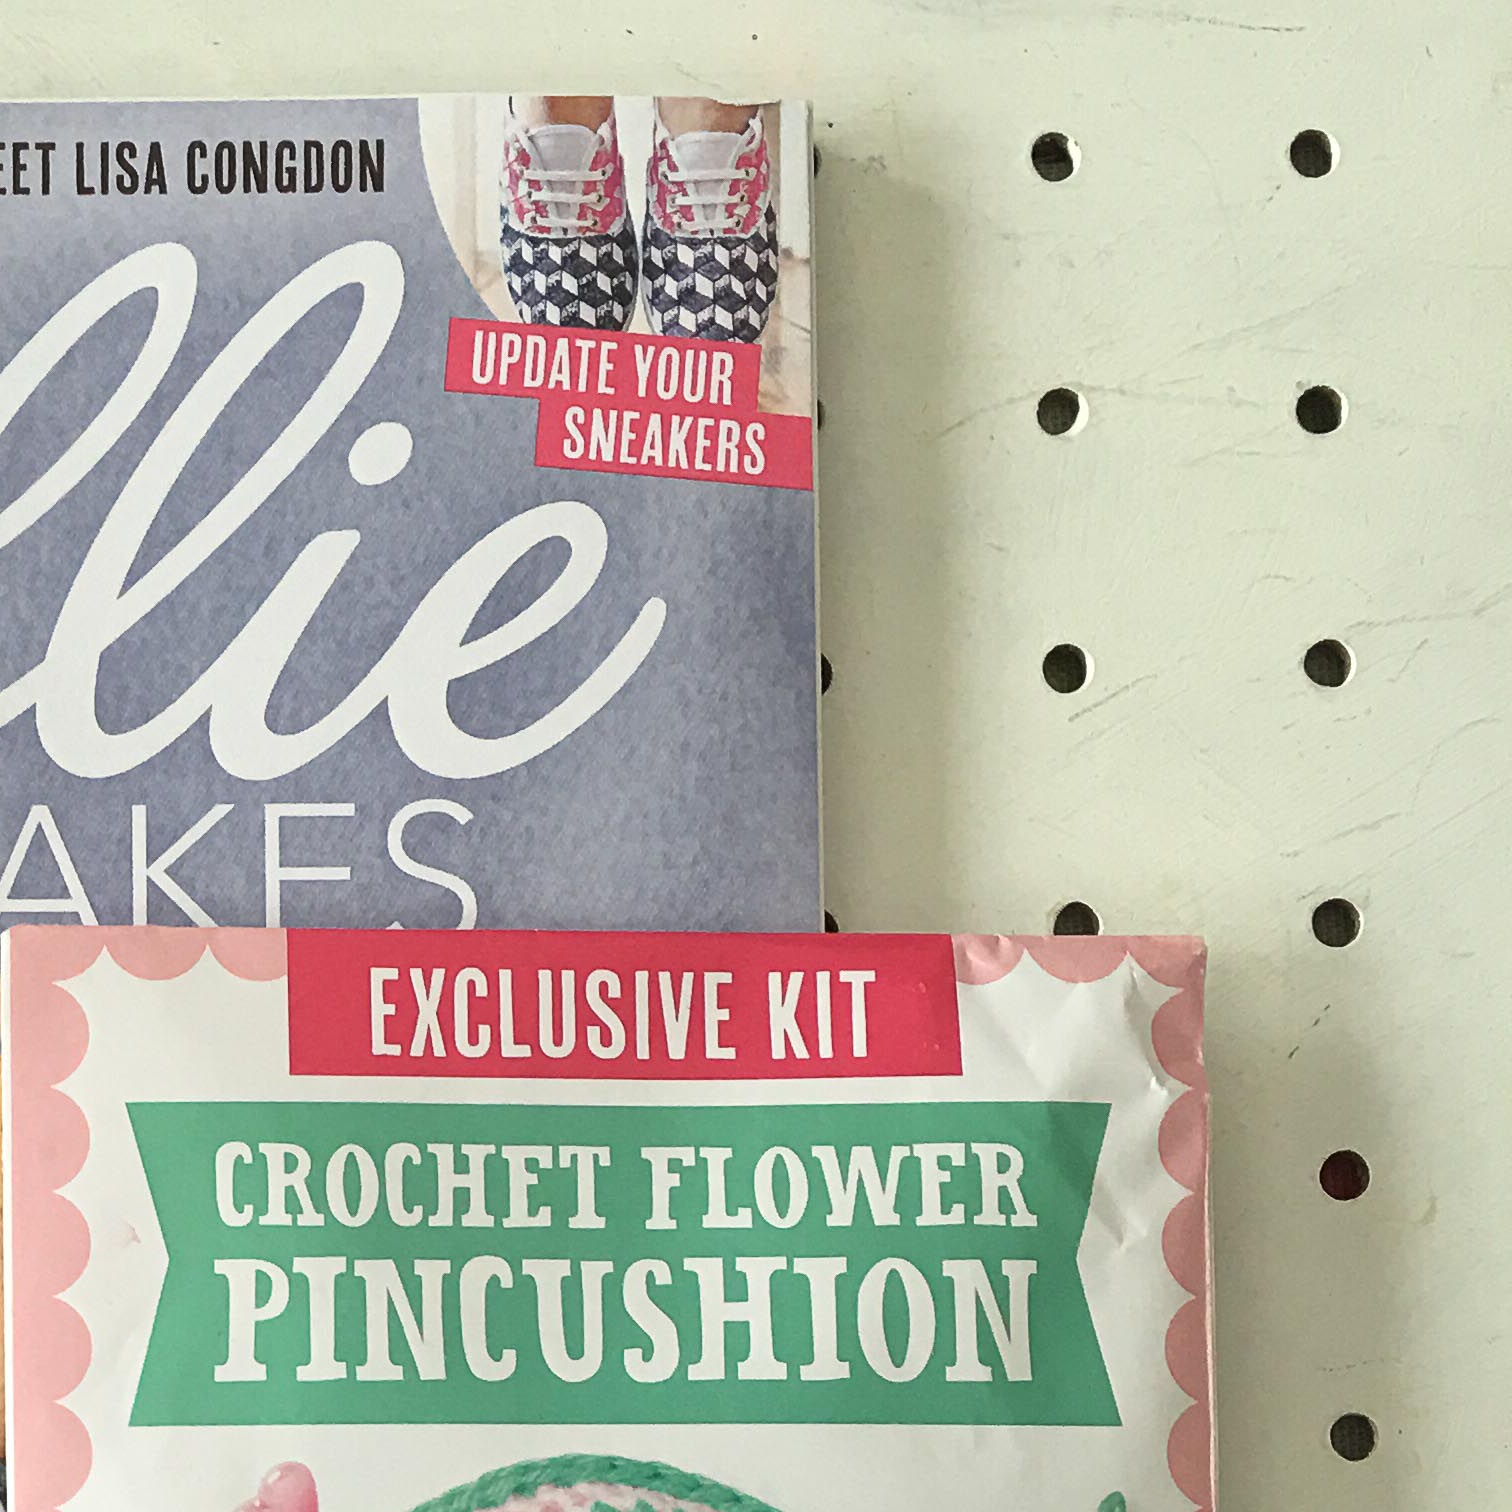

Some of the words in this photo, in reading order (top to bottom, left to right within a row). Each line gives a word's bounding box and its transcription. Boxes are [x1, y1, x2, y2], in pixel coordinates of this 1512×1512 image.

[76, 141, 167, 195] LISA
[188, 138, 385, 193] CONGDON
[471, 330, 617, 395] UPDATE
[634, 344, 734, 405] YOUR
[563, 406, 765, 475] SNEAKERS
[369, 966, 737, 1061] EXCLUSIVE
[768, 969, 877, 1060] KIT
[213, 1141, 611, 1231] CROCHET
[639, 1142, 1038, 1229] FLOWER
[213, 1254, 1038, 1384] PINCUSHION
